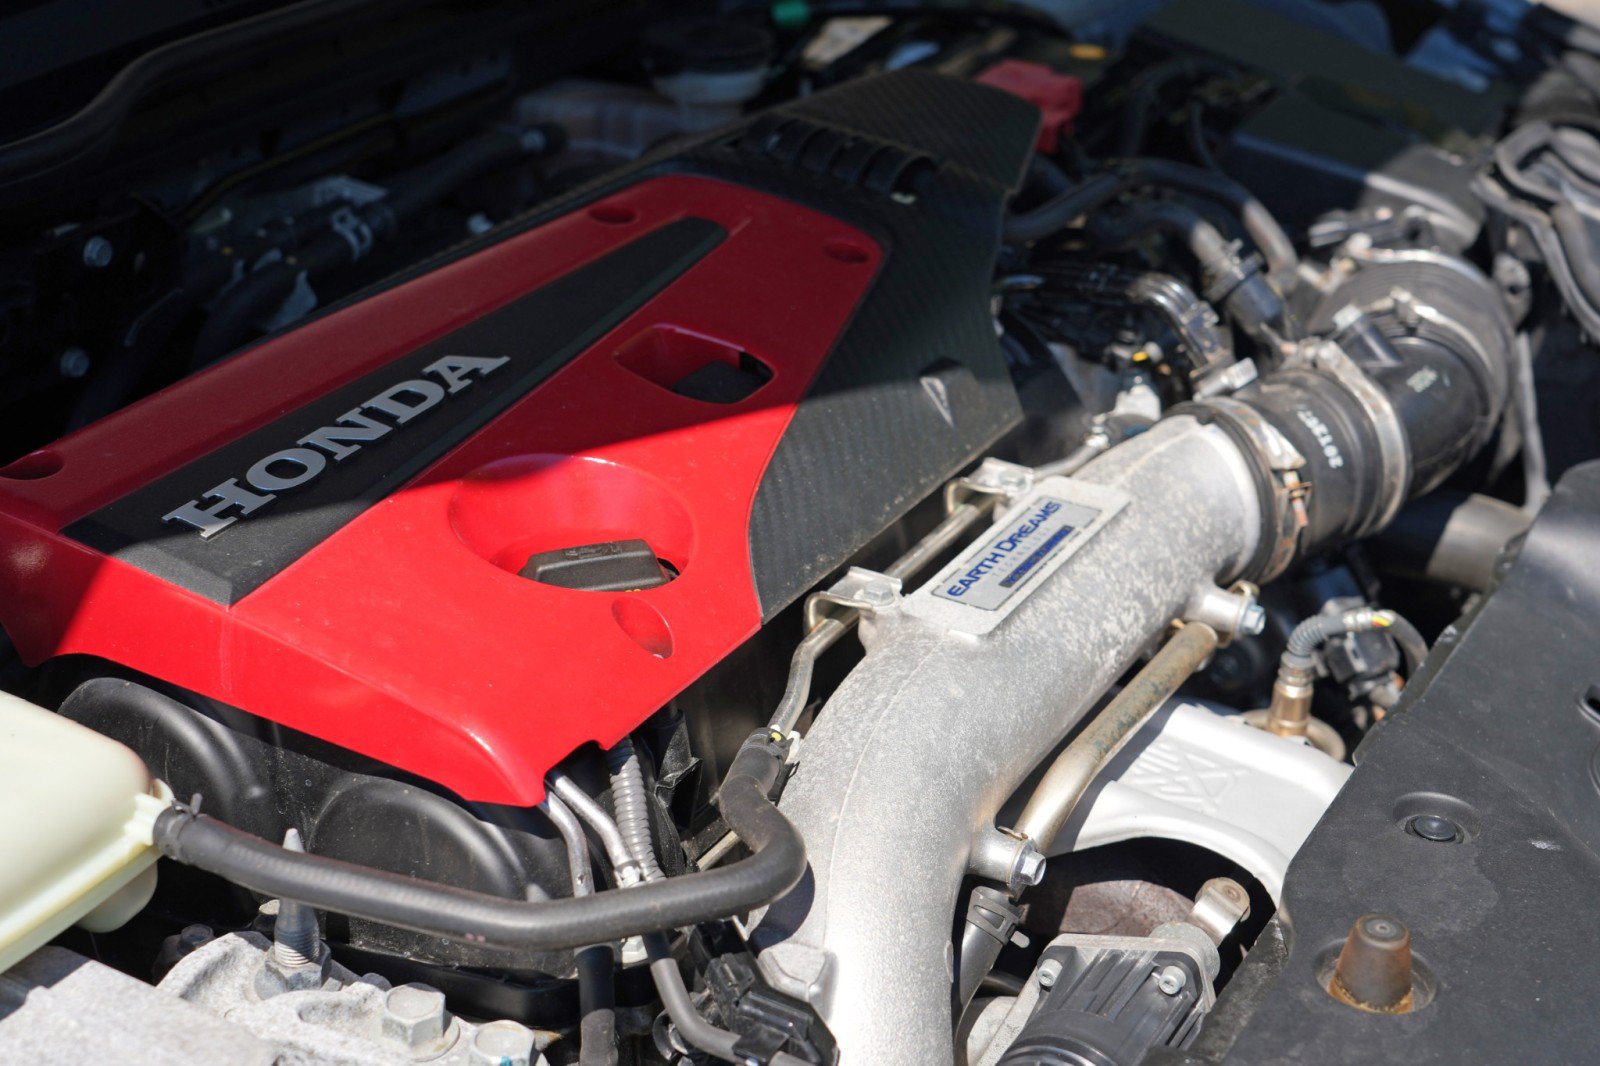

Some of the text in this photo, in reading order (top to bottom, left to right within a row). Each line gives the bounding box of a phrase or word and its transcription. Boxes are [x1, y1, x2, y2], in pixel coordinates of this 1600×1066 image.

[161, 354, 511, 541] HONDA
[947, 552, 1005, 597] EARTH
[997, 501, 1062, 553] DREAMS
